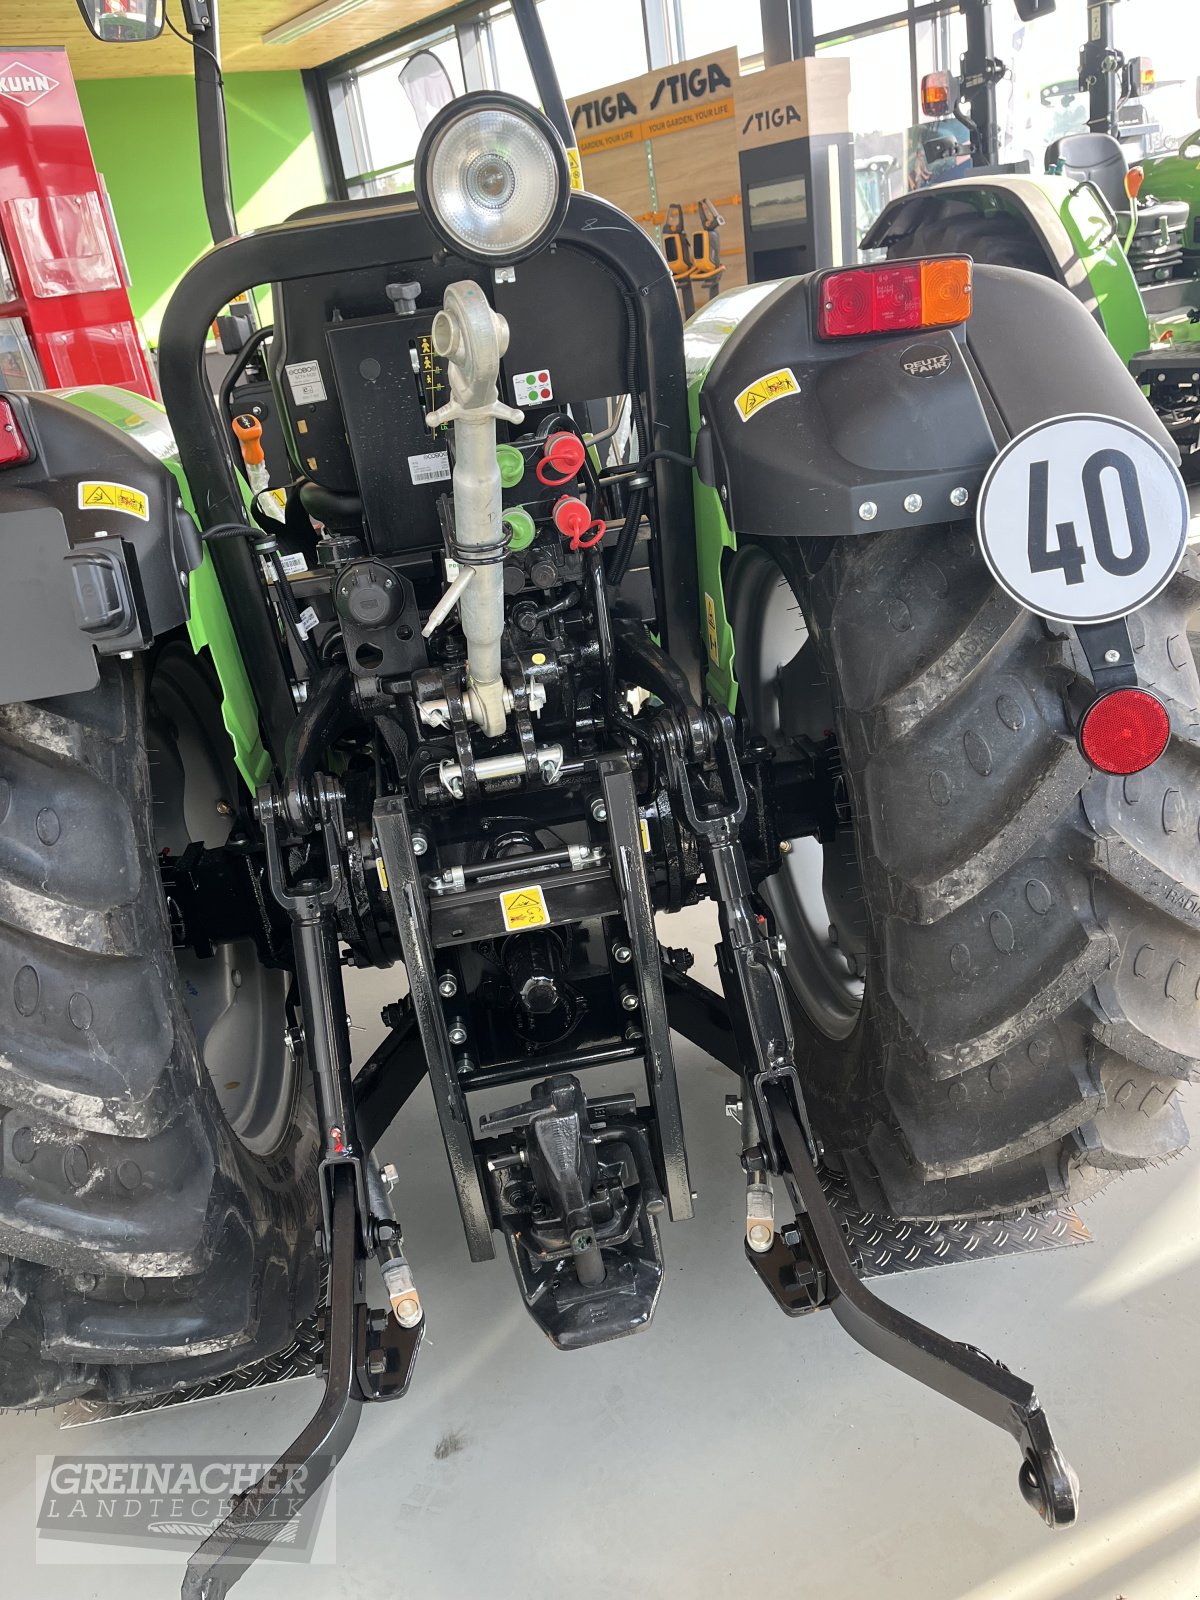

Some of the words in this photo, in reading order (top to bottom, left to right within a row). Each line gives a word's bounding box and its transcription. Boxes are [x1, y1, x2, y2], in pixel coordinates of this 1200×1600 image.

[0, 76, 50, 91] KUHN
[650, 63, 731, 110] STIGA
[571, 92, 637, 130] STIGA
[649, 121, 666, 133] YOUR
[695, 109, 713, 121] YOUR
[714, 104, 728, 116] LIFE
[742, 105, 801, 135] STIGA
[903, 354, 949, 370] DEUTZ
[910, 361, 947, 374] FAHR
[1028, 448, 1150, 585] 40
